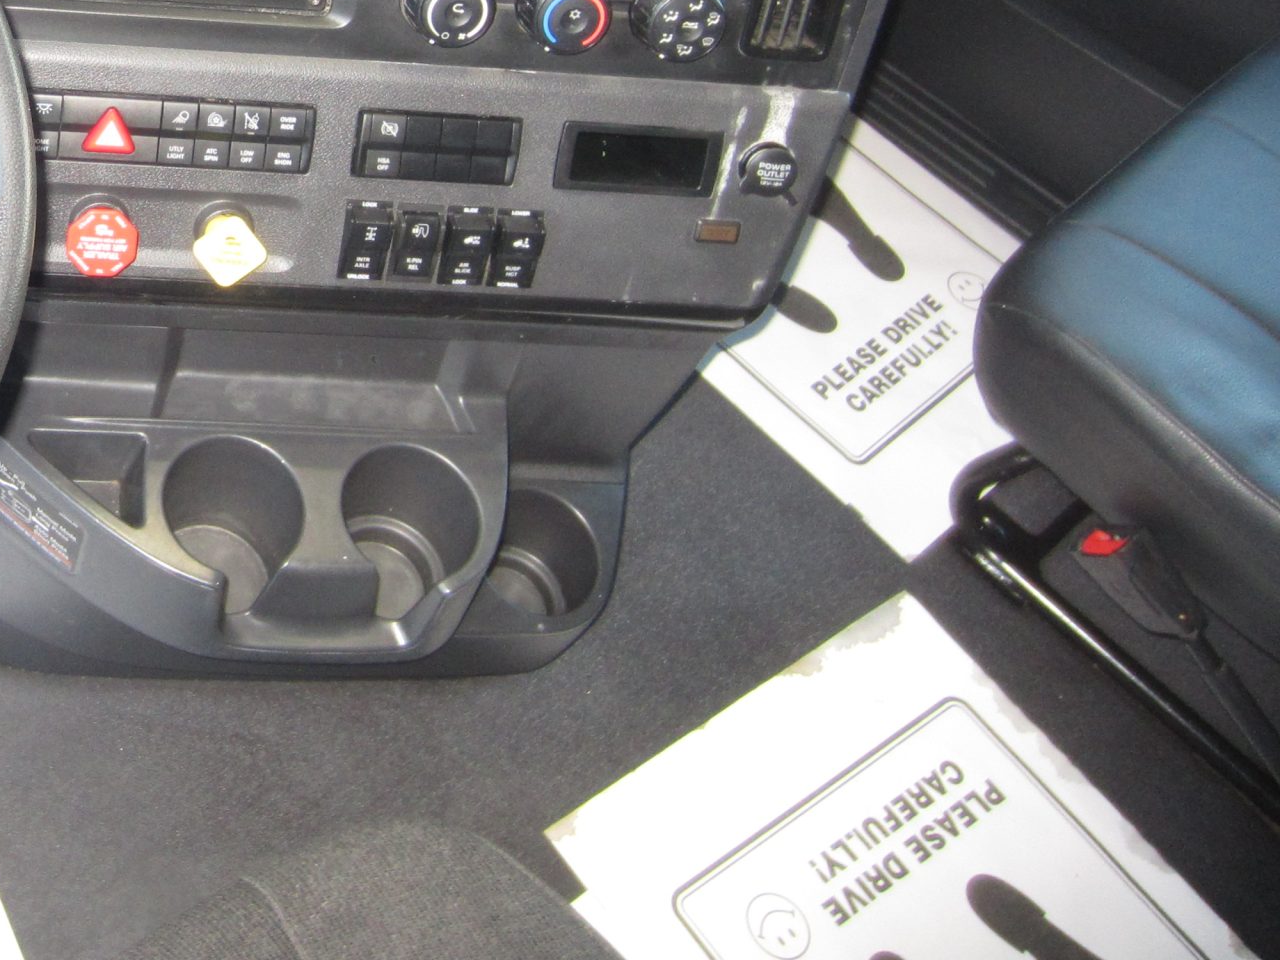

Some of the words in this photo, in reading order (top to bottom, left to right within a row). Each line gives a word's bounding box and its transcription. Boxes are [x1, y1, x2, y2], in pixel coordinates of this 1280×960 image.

[757, 169, 789, 178] OUTLET
[759, 162, 791, 171] POWER
[77, 242, 111, 251] SUPPLY
[112, 244, 128, 253] AIR
[810, 336, 889, 400] PLEASE
[882, 293, 944, 348] DRIVE
[845, 319, 958, 412] CAREFULLY!
[808, 759, 965, 884] CAREFULLY!
[903, 778, 1006, 864] PLEASE
[821, 851, 910, 927] DRIVE
